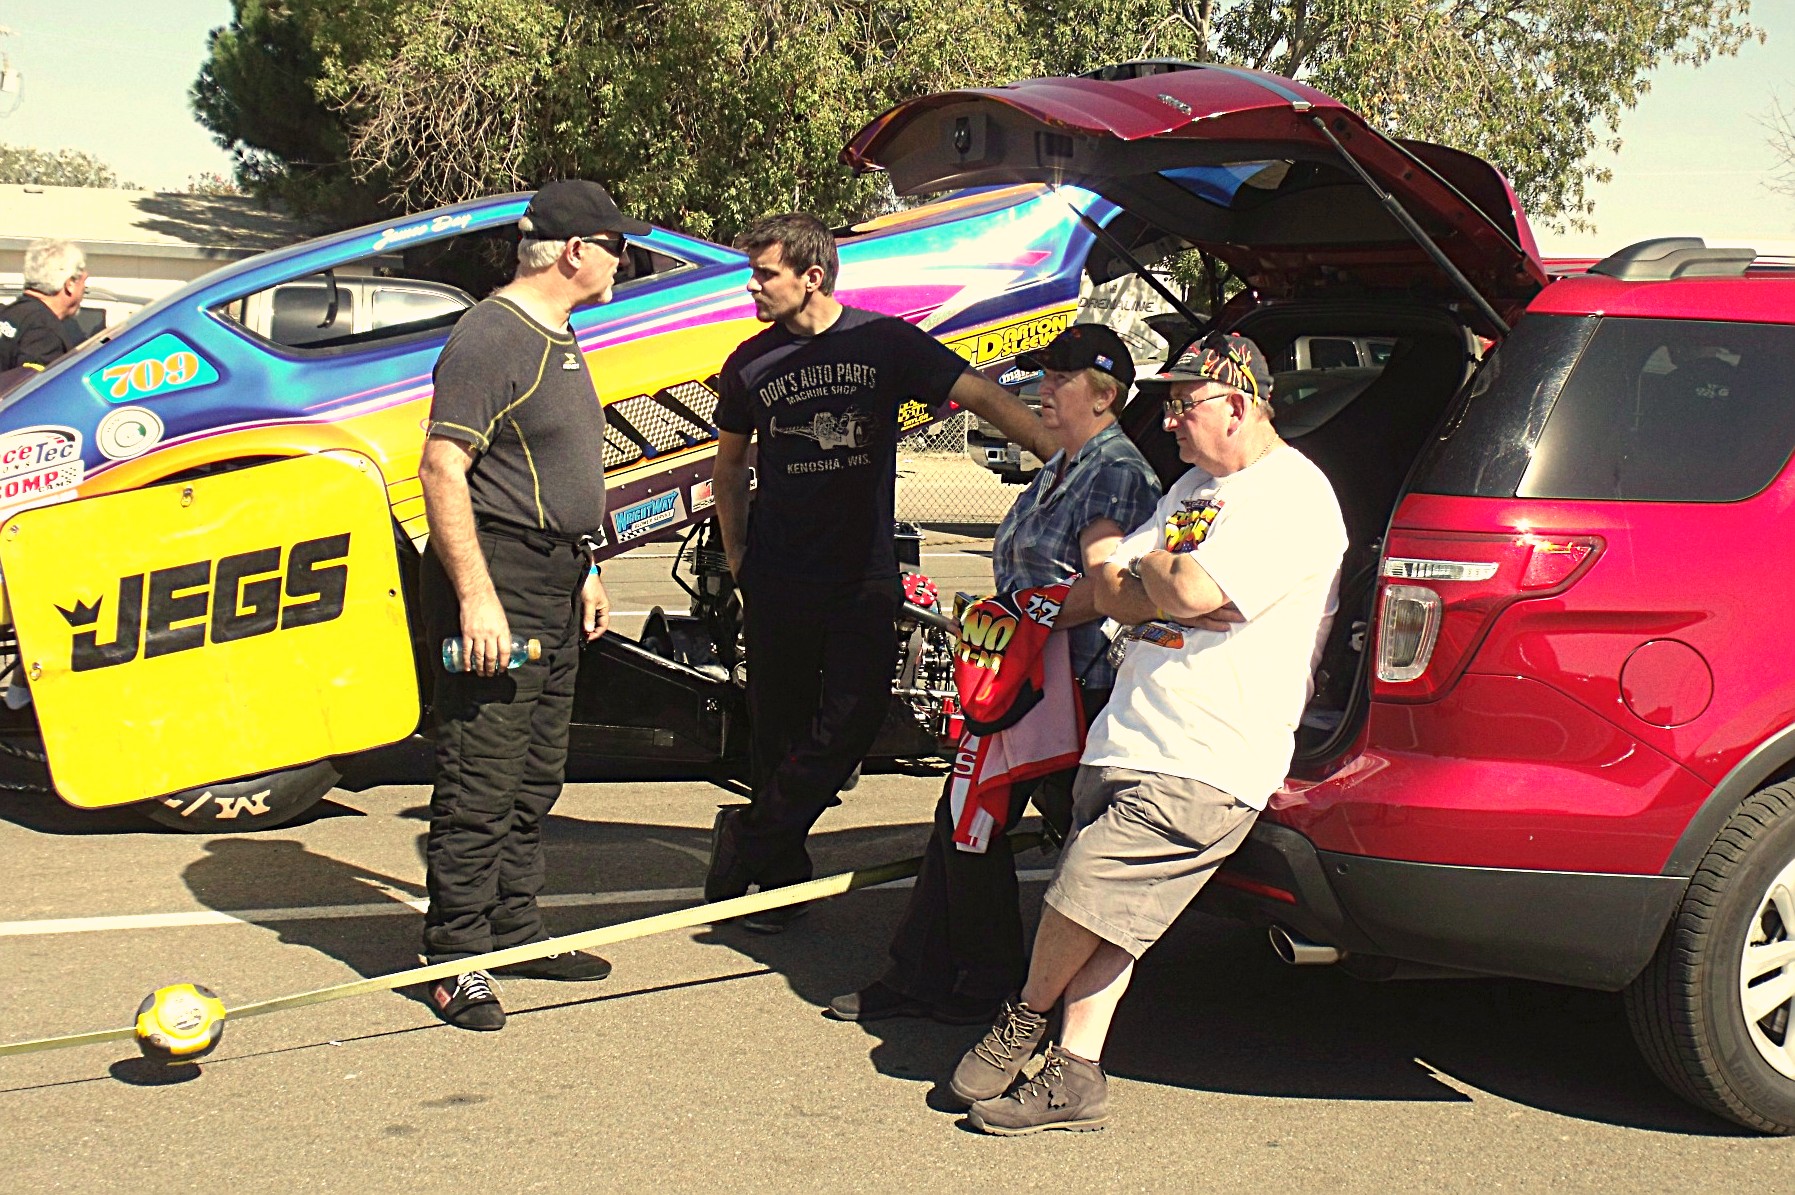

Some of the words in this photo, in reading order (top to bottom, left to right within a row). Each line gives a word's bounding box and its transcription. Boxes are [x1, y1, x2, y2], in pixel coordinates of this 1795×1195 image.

[976, 314, 1067, 364] DARTON
[103, 351, 199, 398] 709
[760, 372, 798, 408] DON'S
[800, 364, 833, 389] AUTO
[836, 362, 877, 389] PARTS
[786, 386, 829, 405] MACHINE
[831, 385, 857, 395] SHOP
[0, 441, 74, 465] ceTec
[0, 470, 59, 499] OMP
[71, 533, 351, 672] JEGS
